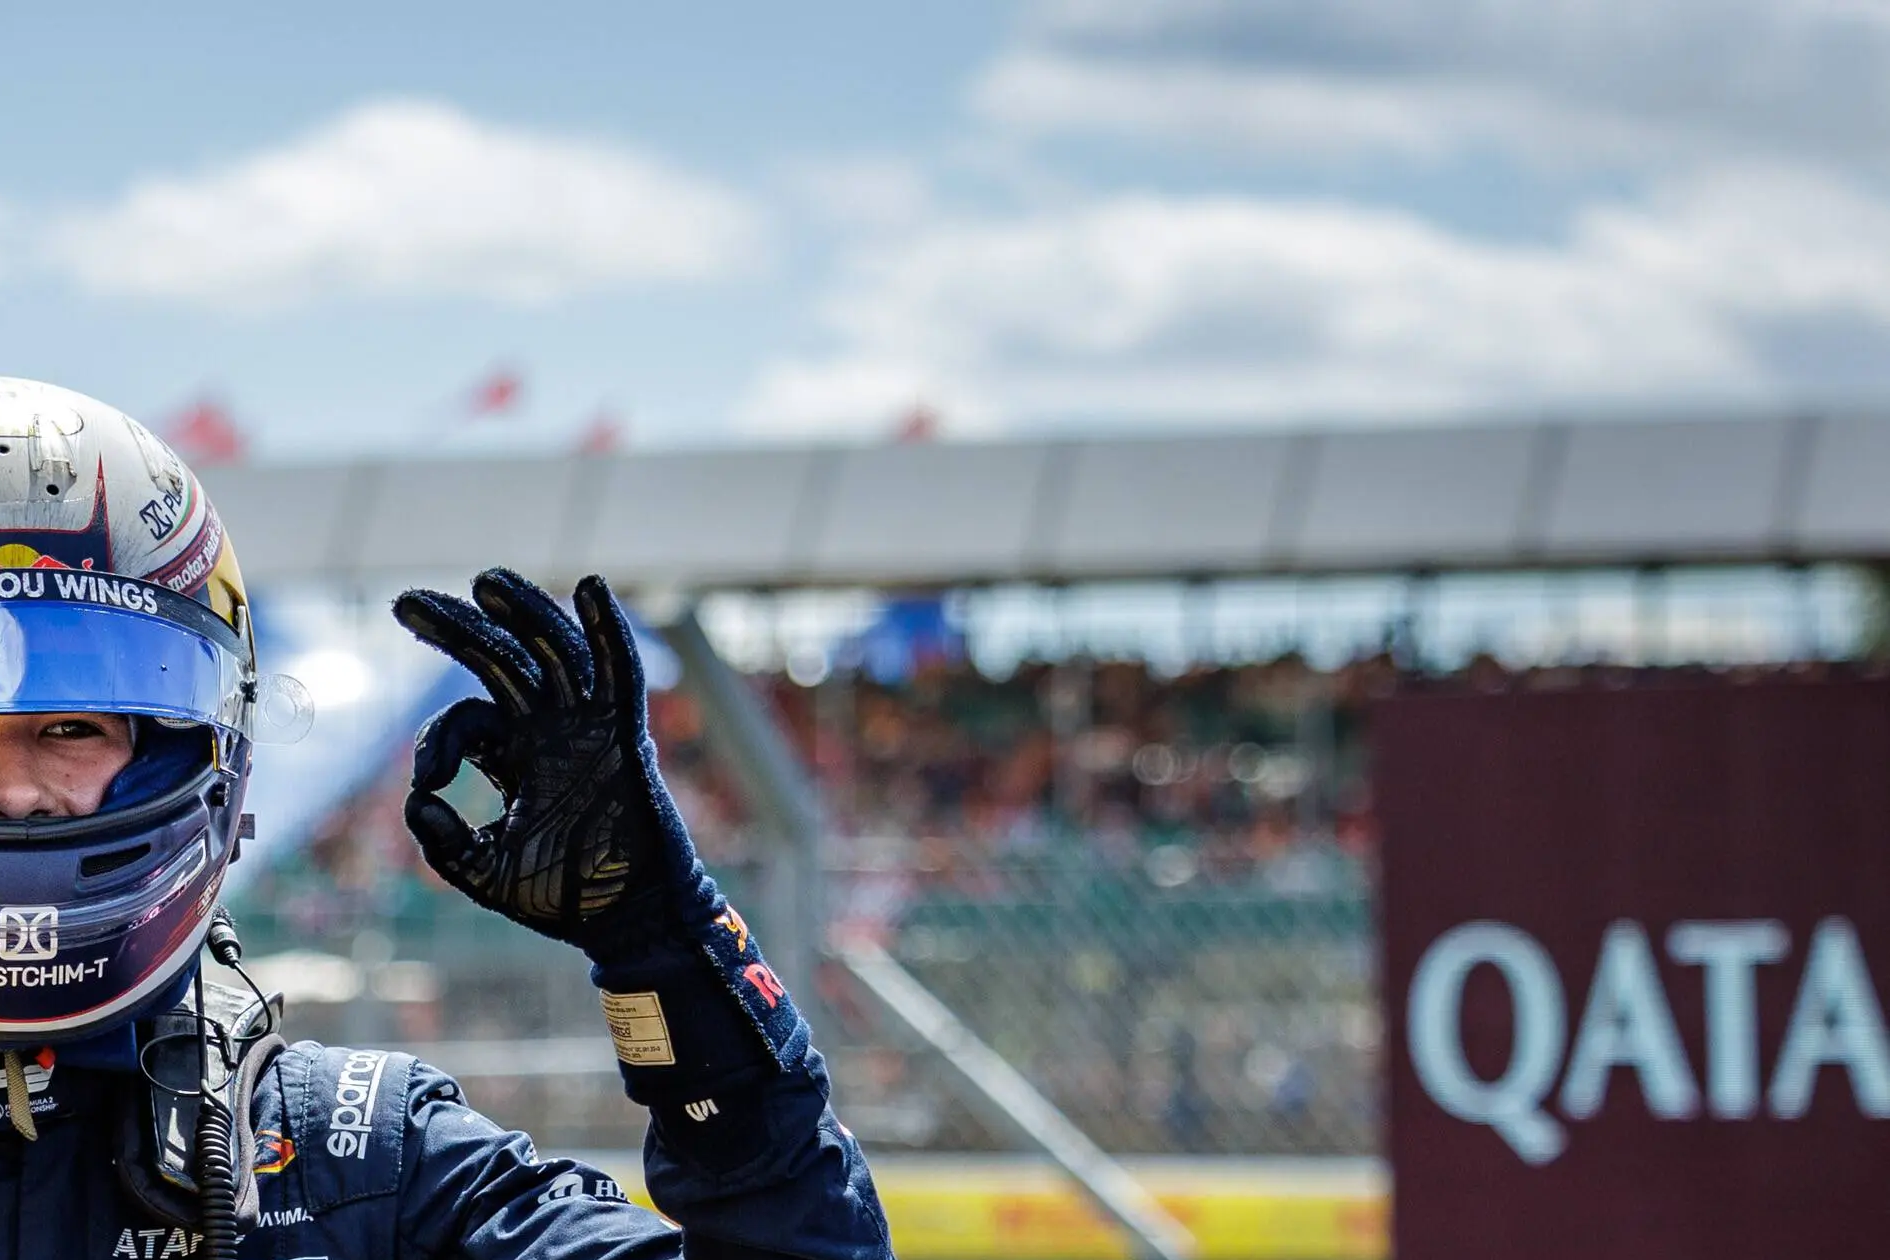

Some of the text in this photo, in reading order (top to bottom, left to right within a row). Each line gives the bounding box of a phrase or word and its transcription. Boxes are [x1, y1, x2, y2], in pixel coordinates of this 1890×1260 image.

[54, 573, 158, 614] WINGS
[1406, 917, 1890, 1166] QATA
[327, 1052, 383, 1158] sparco
